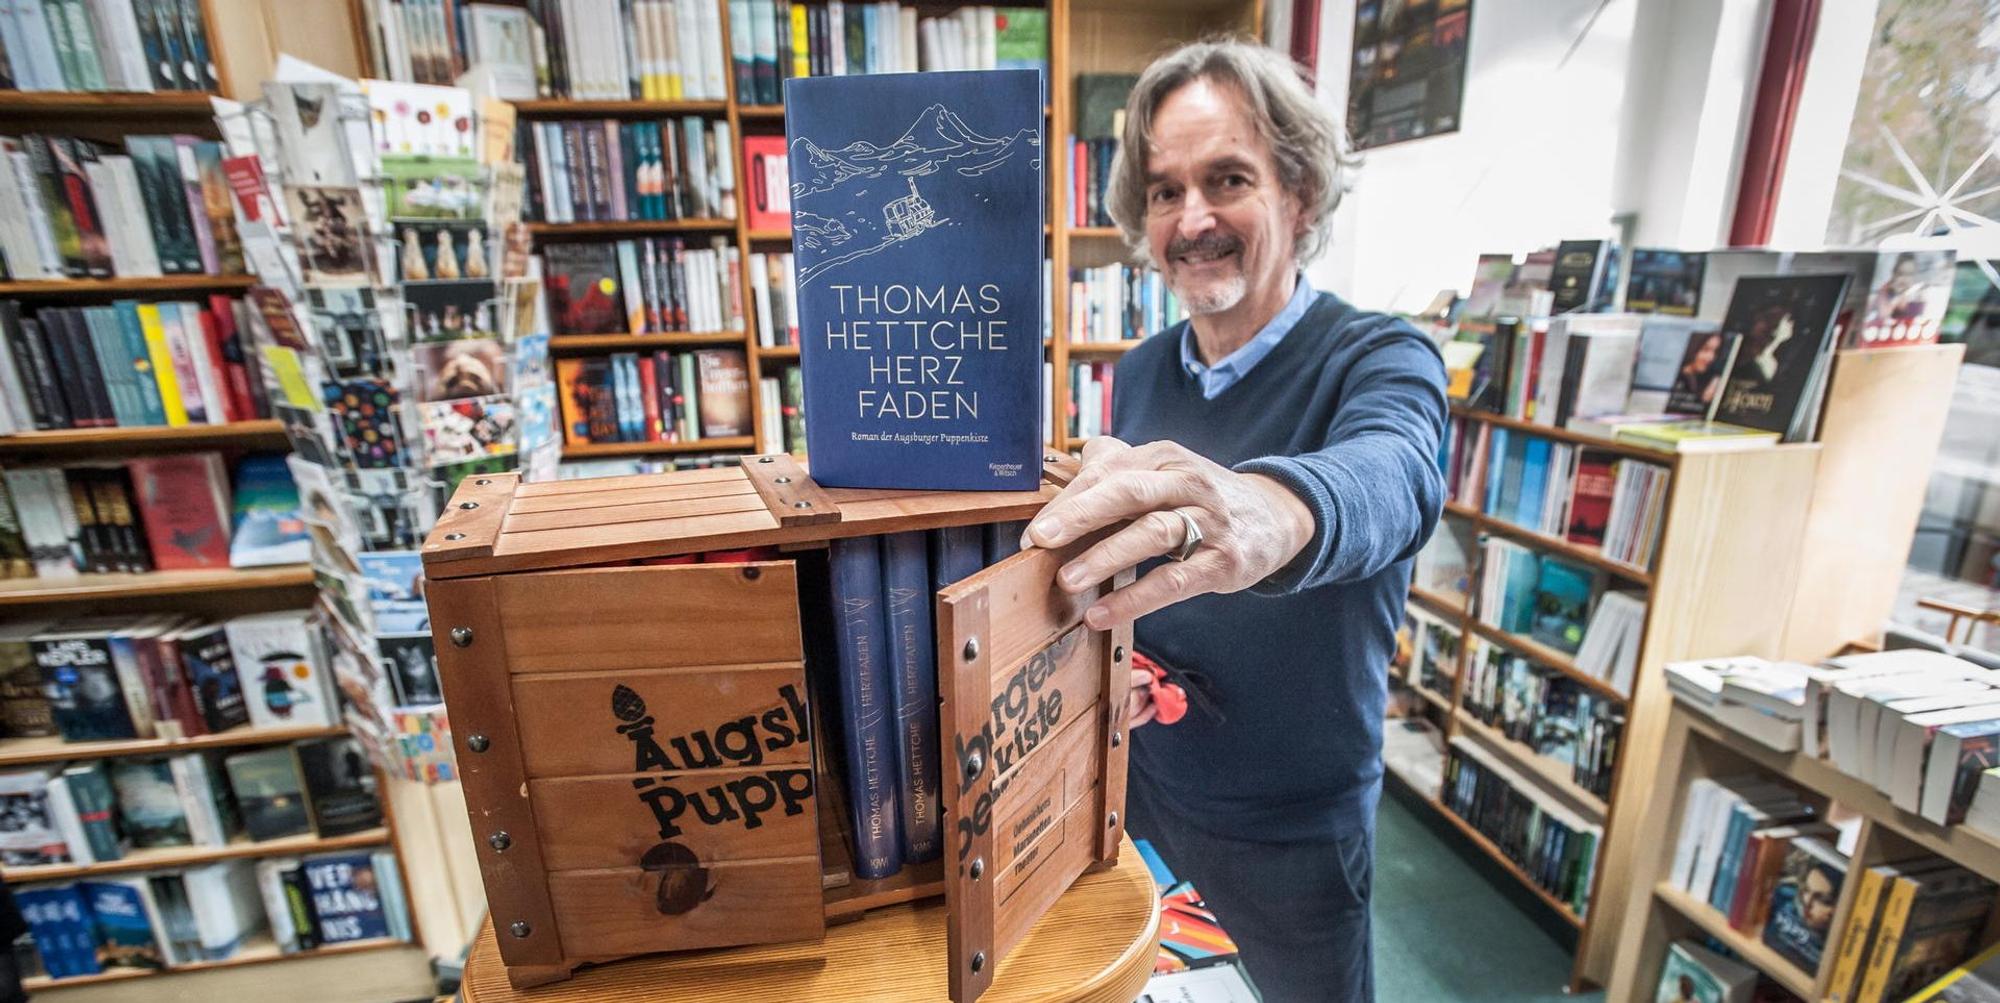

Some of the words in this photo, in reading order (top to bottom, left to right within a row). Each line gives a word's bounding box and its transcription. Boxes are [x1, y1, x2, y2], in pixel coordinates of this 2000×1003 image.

[830, 284, 1001, 315] THOMAS
[826, 320, 1008, 350] HETTCHE
[870, 355, 964, 385] HERZ
[858, 390, 978, 420] FADEN
[851, 431, 879, 441] Roman
[880, 431, 893, 441] der
[894, 432, 938, 445] Augsburger
[940, 433, 989, 445] Puppenkiste
[858, 635, 873, 707] HERZFADEN
[904, 624, 919, 695] HERZFADEN
[865, 735, 880, 790] HETTCHE
[909, 722, 923, 776] HETTCHE
[871, 792, 884, 841] THOMAS
[914, 779, 926, 825] THOMAS
